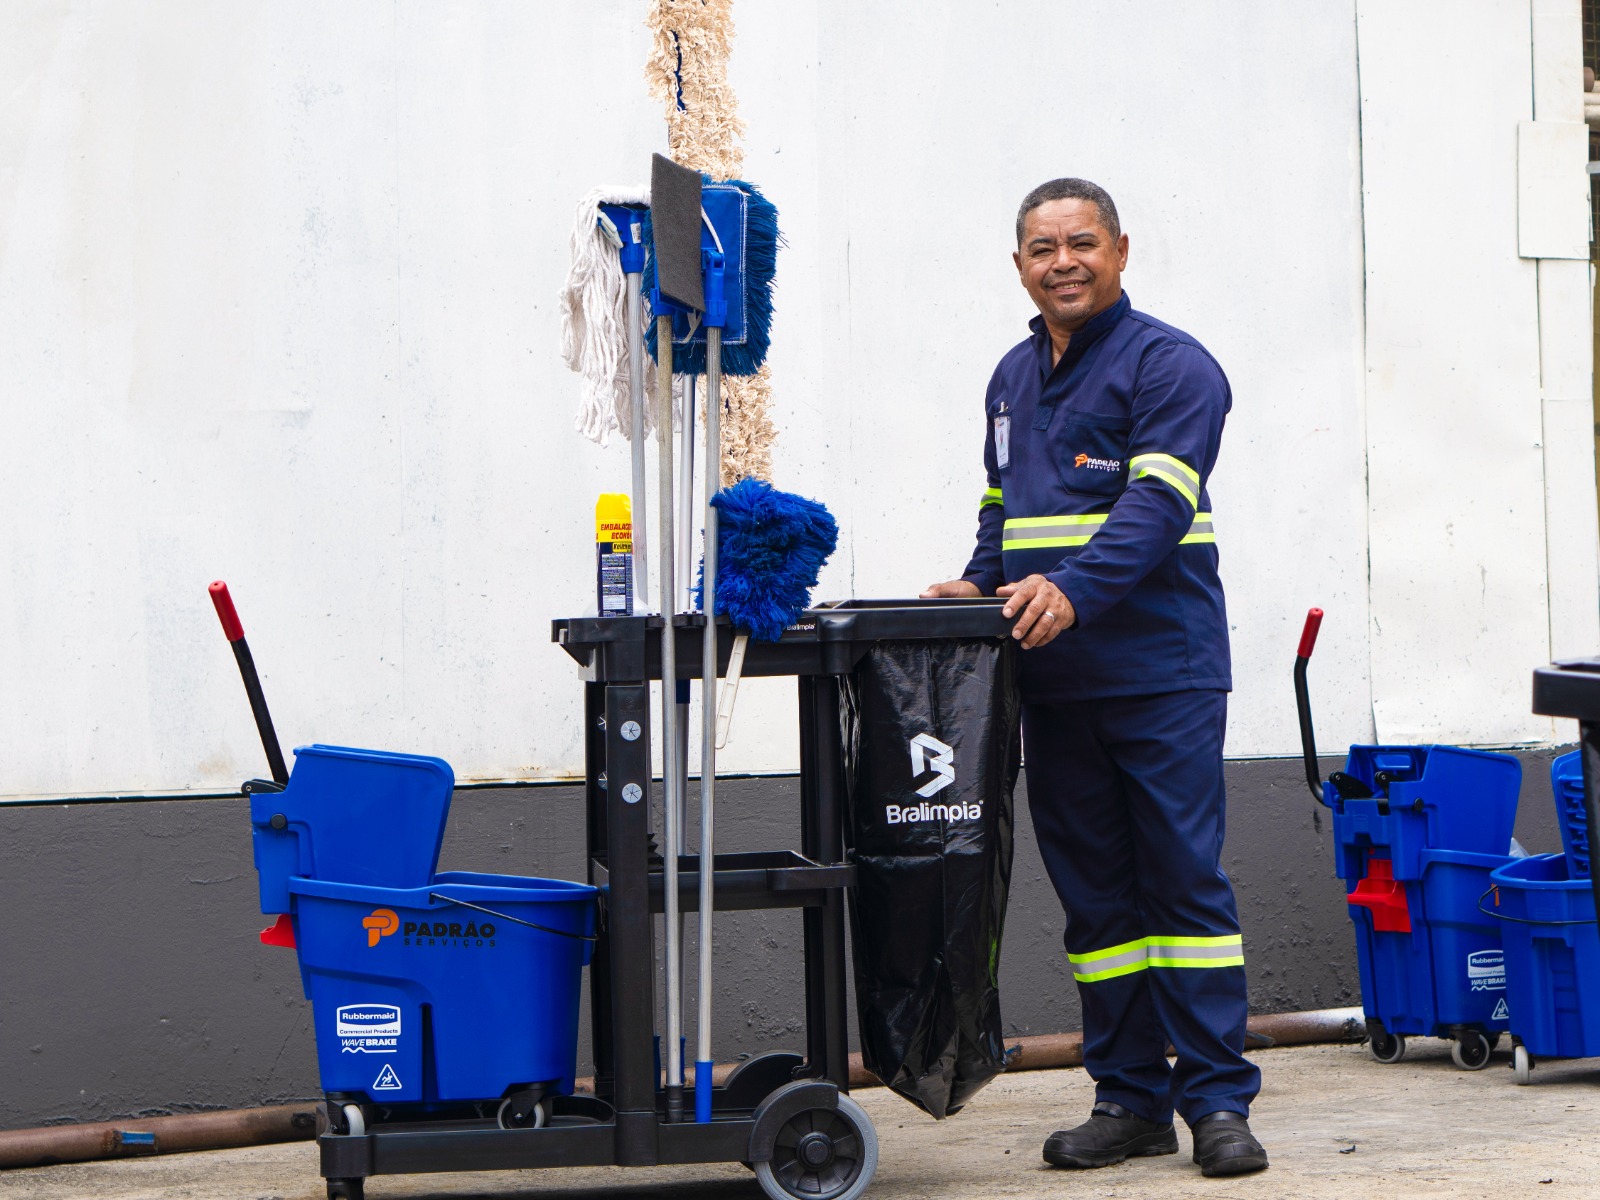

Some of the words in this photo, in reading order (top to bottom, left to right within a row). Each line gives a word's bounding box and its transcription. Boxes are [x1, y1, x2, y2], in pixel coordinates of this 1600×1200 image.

[1087, 458, 1120, 467] PADRÃO
[404, 920, 495, 938] PADRÃO
[404, 939, 495, 948] SERVIÇOS
